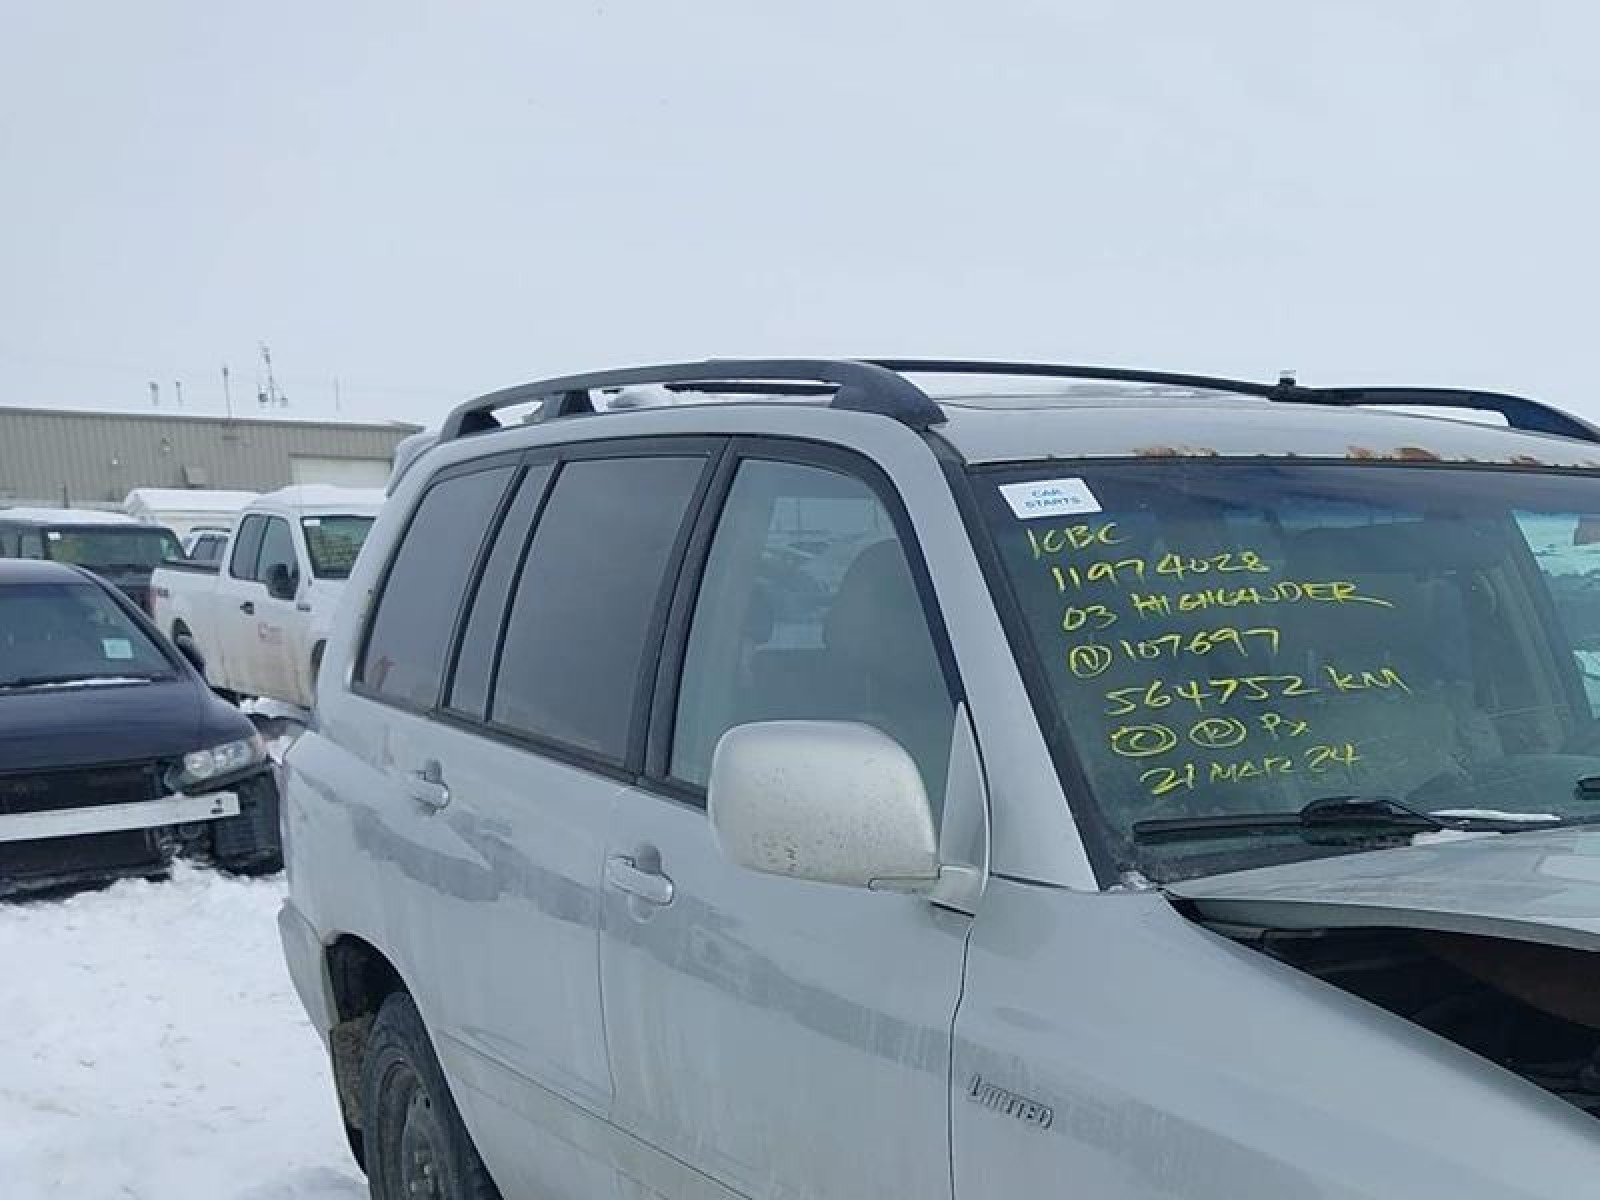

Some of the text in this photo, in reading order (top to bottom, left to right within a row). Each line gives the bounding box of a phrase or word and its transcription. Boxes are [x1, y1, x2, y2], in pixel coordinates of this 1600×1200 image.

[1051, 550, 1270, 592] 11974028
[1063, 604, 1118, 631] 03
[1120, 628, 1280, 661] 107697
[1104, 675, 1320, 715] 564752
[1139, 762, 1195, 795] 21
[1304, 743, 1361, 773] 24
